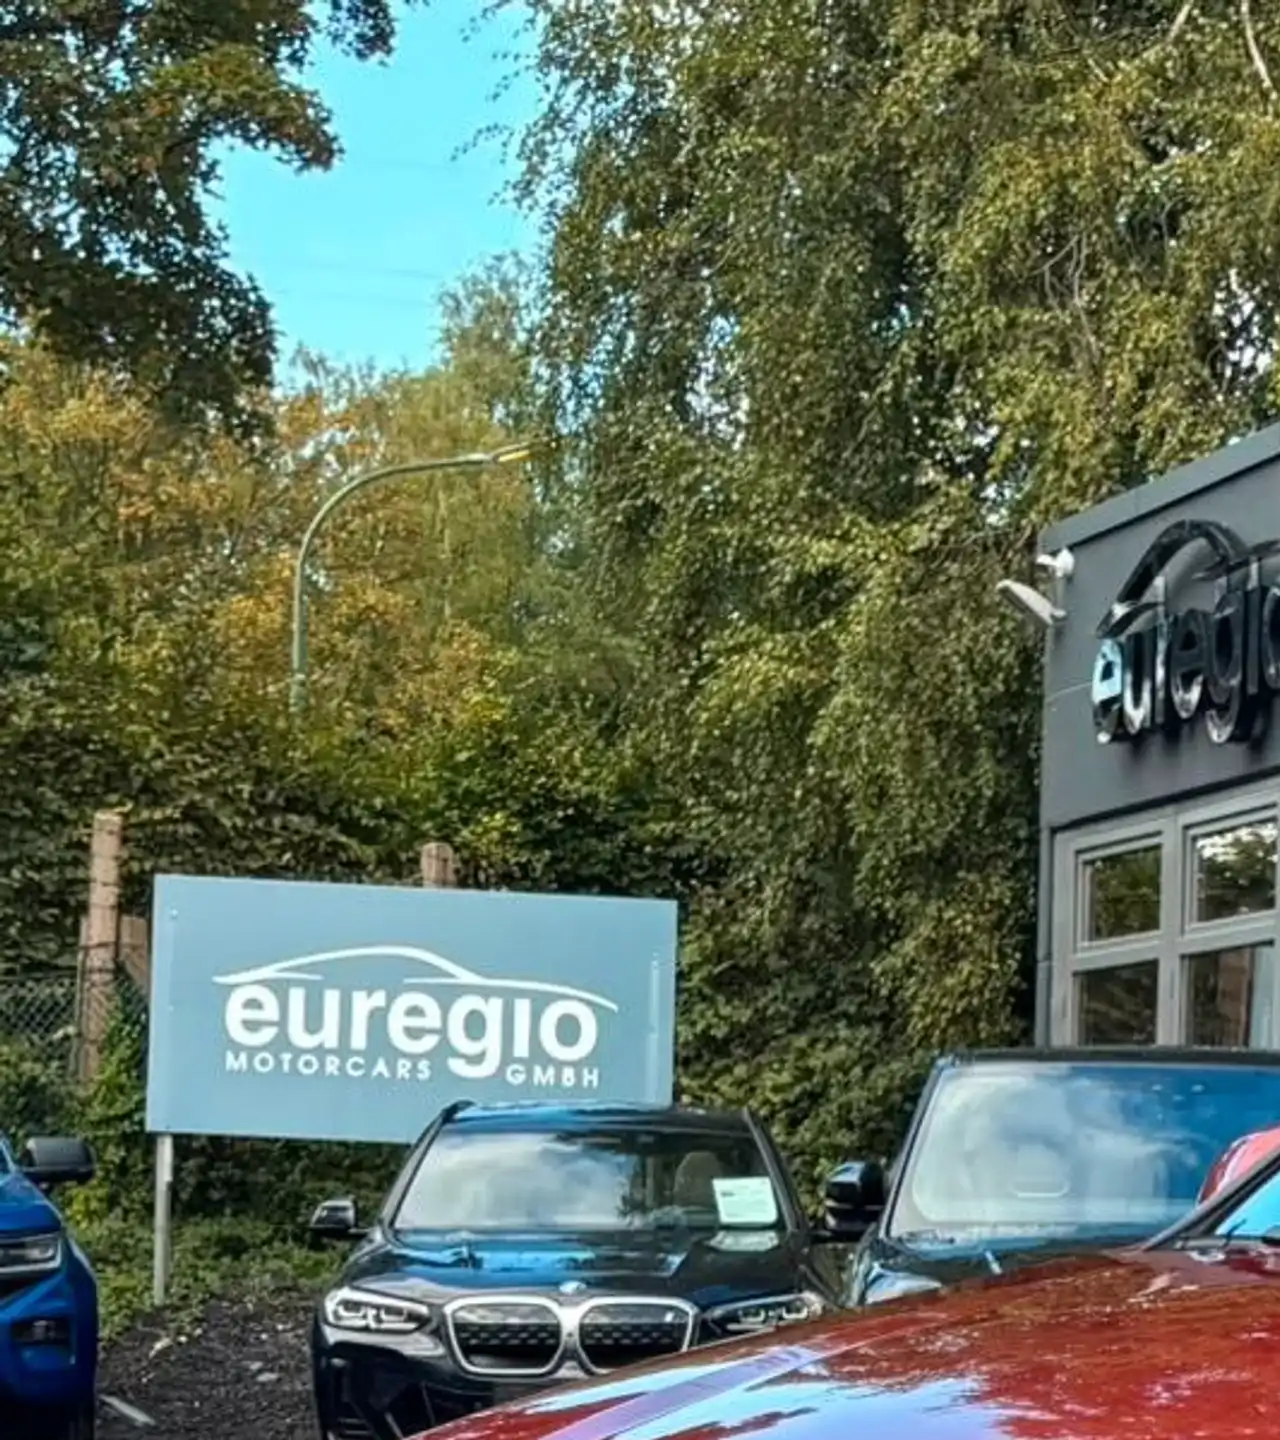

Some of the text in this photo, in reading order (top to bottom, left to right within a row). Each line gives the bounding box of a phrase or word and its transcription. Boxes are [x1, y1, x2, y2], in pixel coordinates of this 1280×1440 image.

[224, 984, 598, 1078] euregio
[226, 1051, 599, 1088] MOTORCARS GMBH
